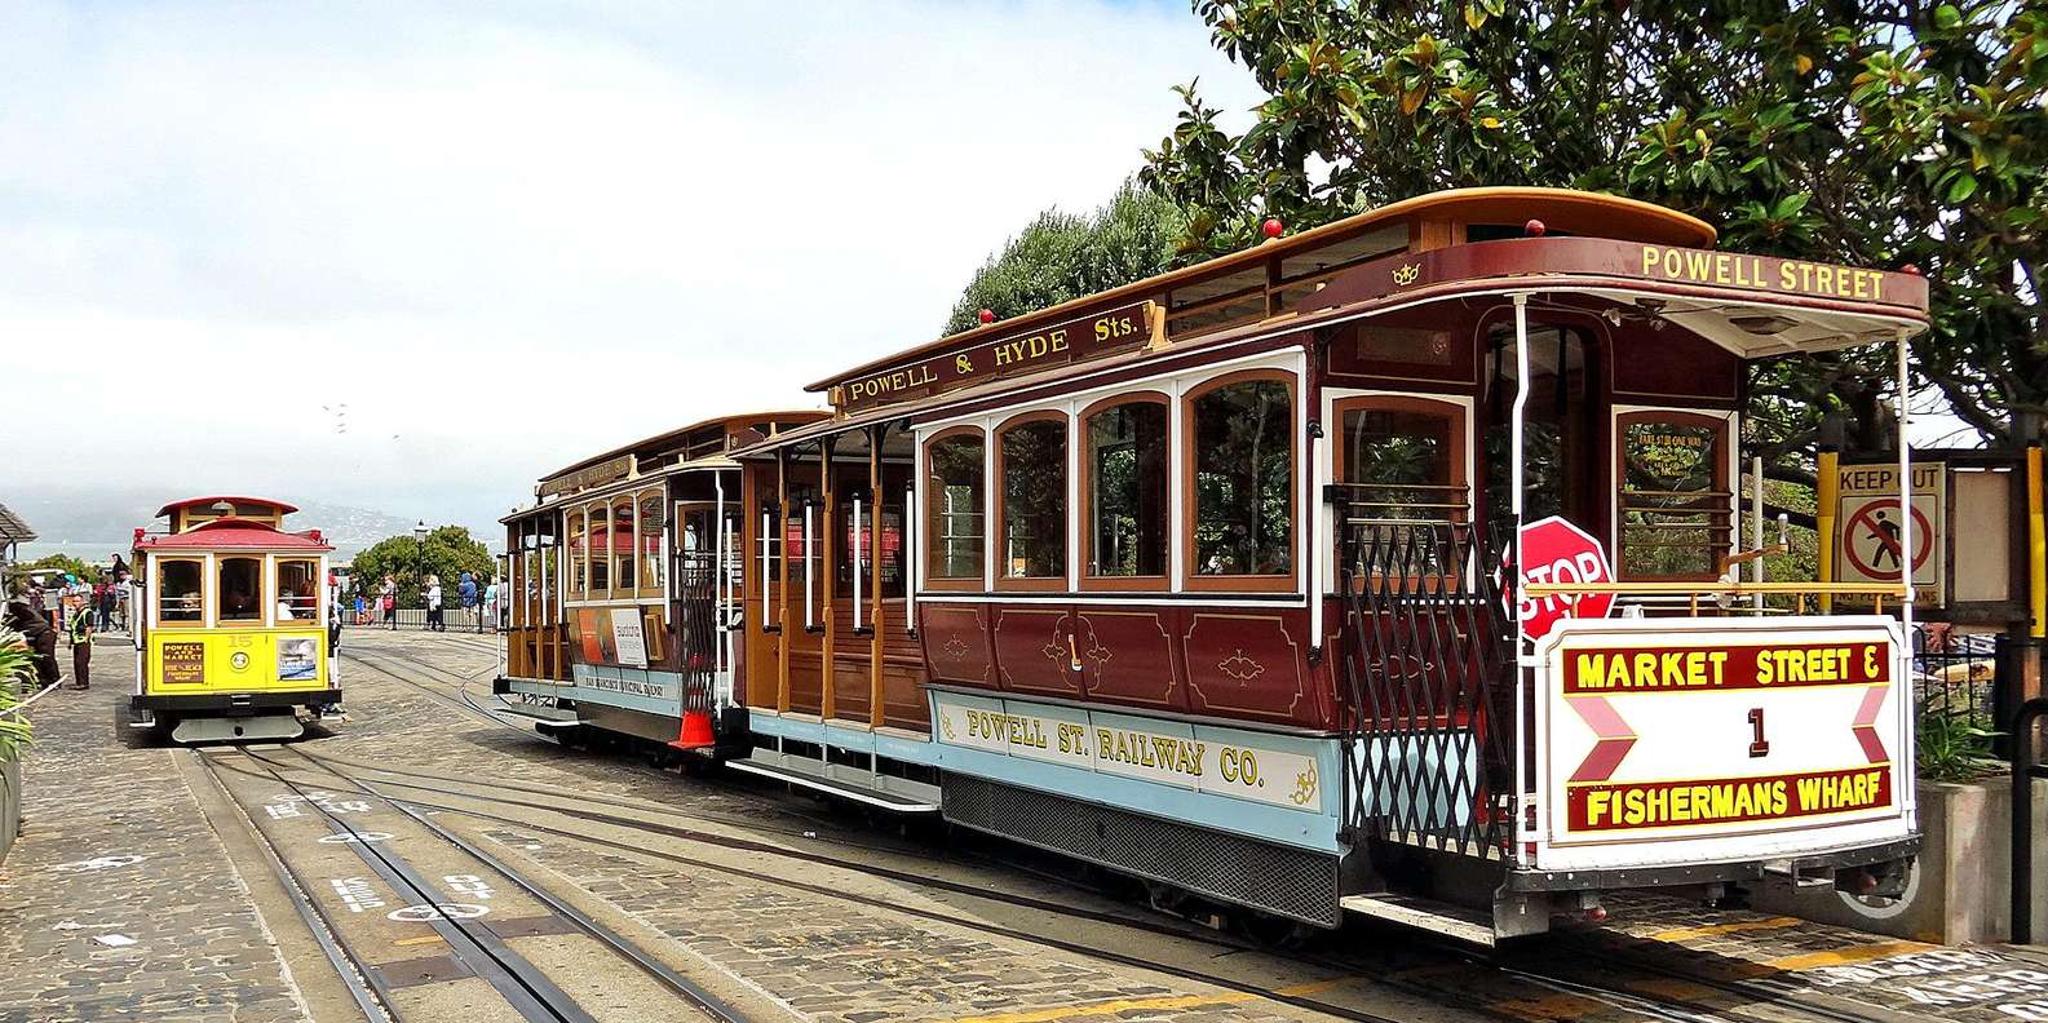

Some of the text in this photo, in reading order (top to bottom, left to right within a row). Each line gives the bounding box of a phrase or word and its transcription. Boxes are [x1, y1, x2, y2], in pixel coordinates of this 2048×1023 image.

[1642, 246, 1884, 300] POWELL STREET
[850, 316, 1139, 401] POWELL & HYDE Sts.
[1840, 468, 1939, 491] KEEP UT
[227, 635, 253, 648] 15
[1577, 652, 1728, 688] MARKET
[1756, 648, 1851, 684] STREET
[967, 709, 1265, 788] POWELL ST. RAILWAY CO.
[1747, 707, 1770, 758] 1
[1587, 771, 1881, 826] FISHERMANS WHARF
